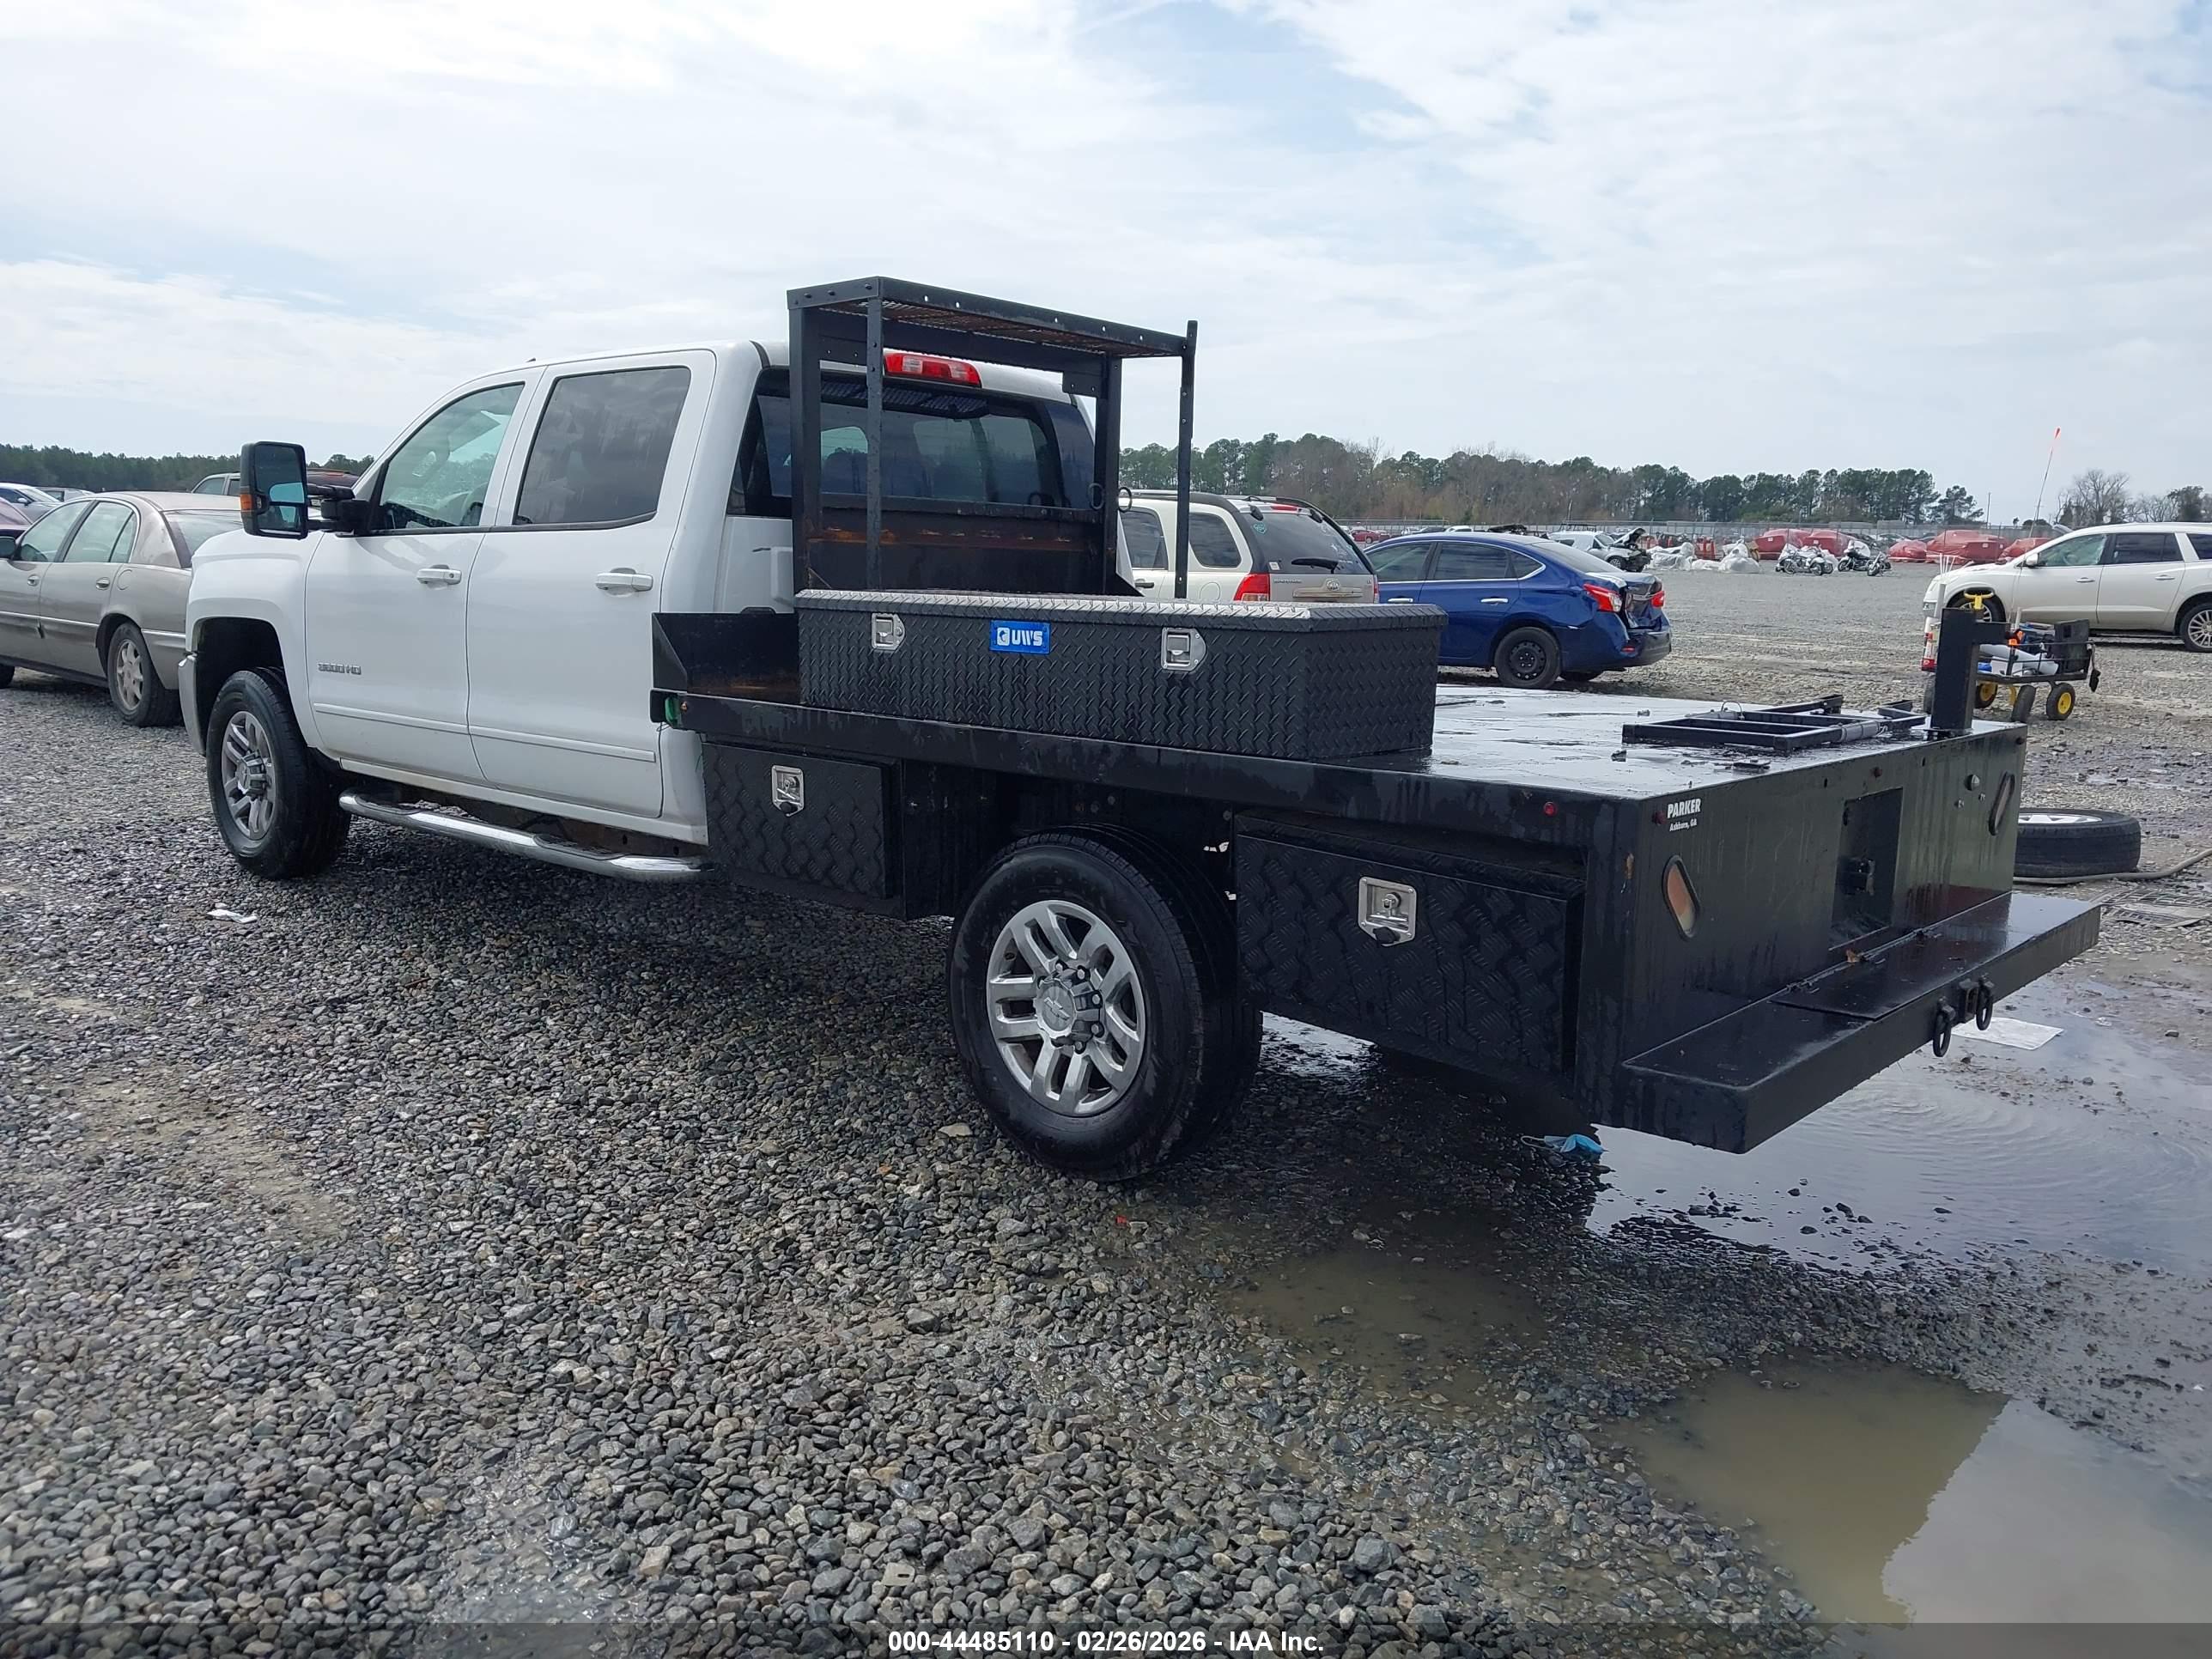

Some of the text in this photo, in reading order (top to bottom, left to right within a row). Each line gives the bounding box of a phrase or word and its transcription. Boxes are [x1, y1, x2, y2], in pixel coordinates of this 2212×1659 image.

[1012, 629, 1043, 647] UWS
[1667, 798, 1702, 819] PARKER
[1690, 817, 1698, 827] GA
